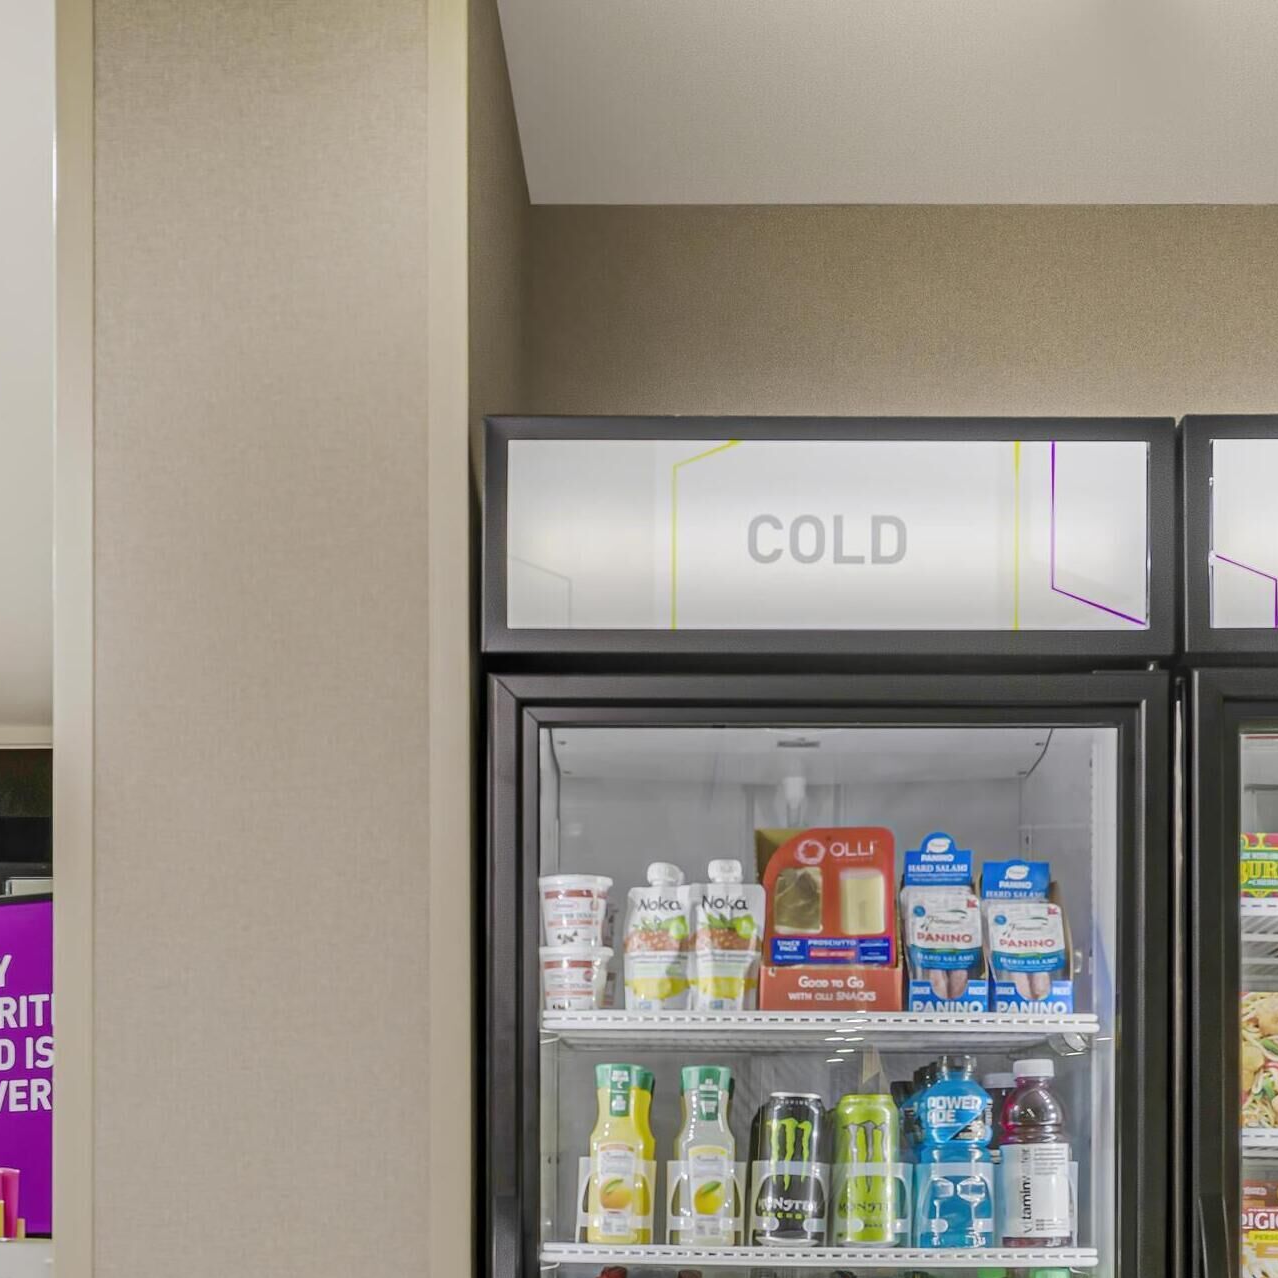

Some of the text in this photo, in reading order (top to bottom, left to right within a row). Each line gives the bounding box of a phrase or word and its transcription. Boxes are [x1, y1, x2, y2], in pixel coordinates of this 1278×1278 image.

[745, 513, 909, 566] COLD
[829, 841, 875, 858] OLLI
[933, 863, 968, 873] SALAMI
[637, 896, 682, 911] Noka
[701, 895, 749, 910] Noka
[916, 931, 973, 944] PANINO
[998, 938, 1056, 949] PANINO
[788, 992, 813, 1001] WITH
[912, 1000, 984, 1013] PANINO
[996, 1000, 1067, 1014] PANINO
[26, 1036, 54, 1069] IS
[927, 1096, 981, 1109] POWER
